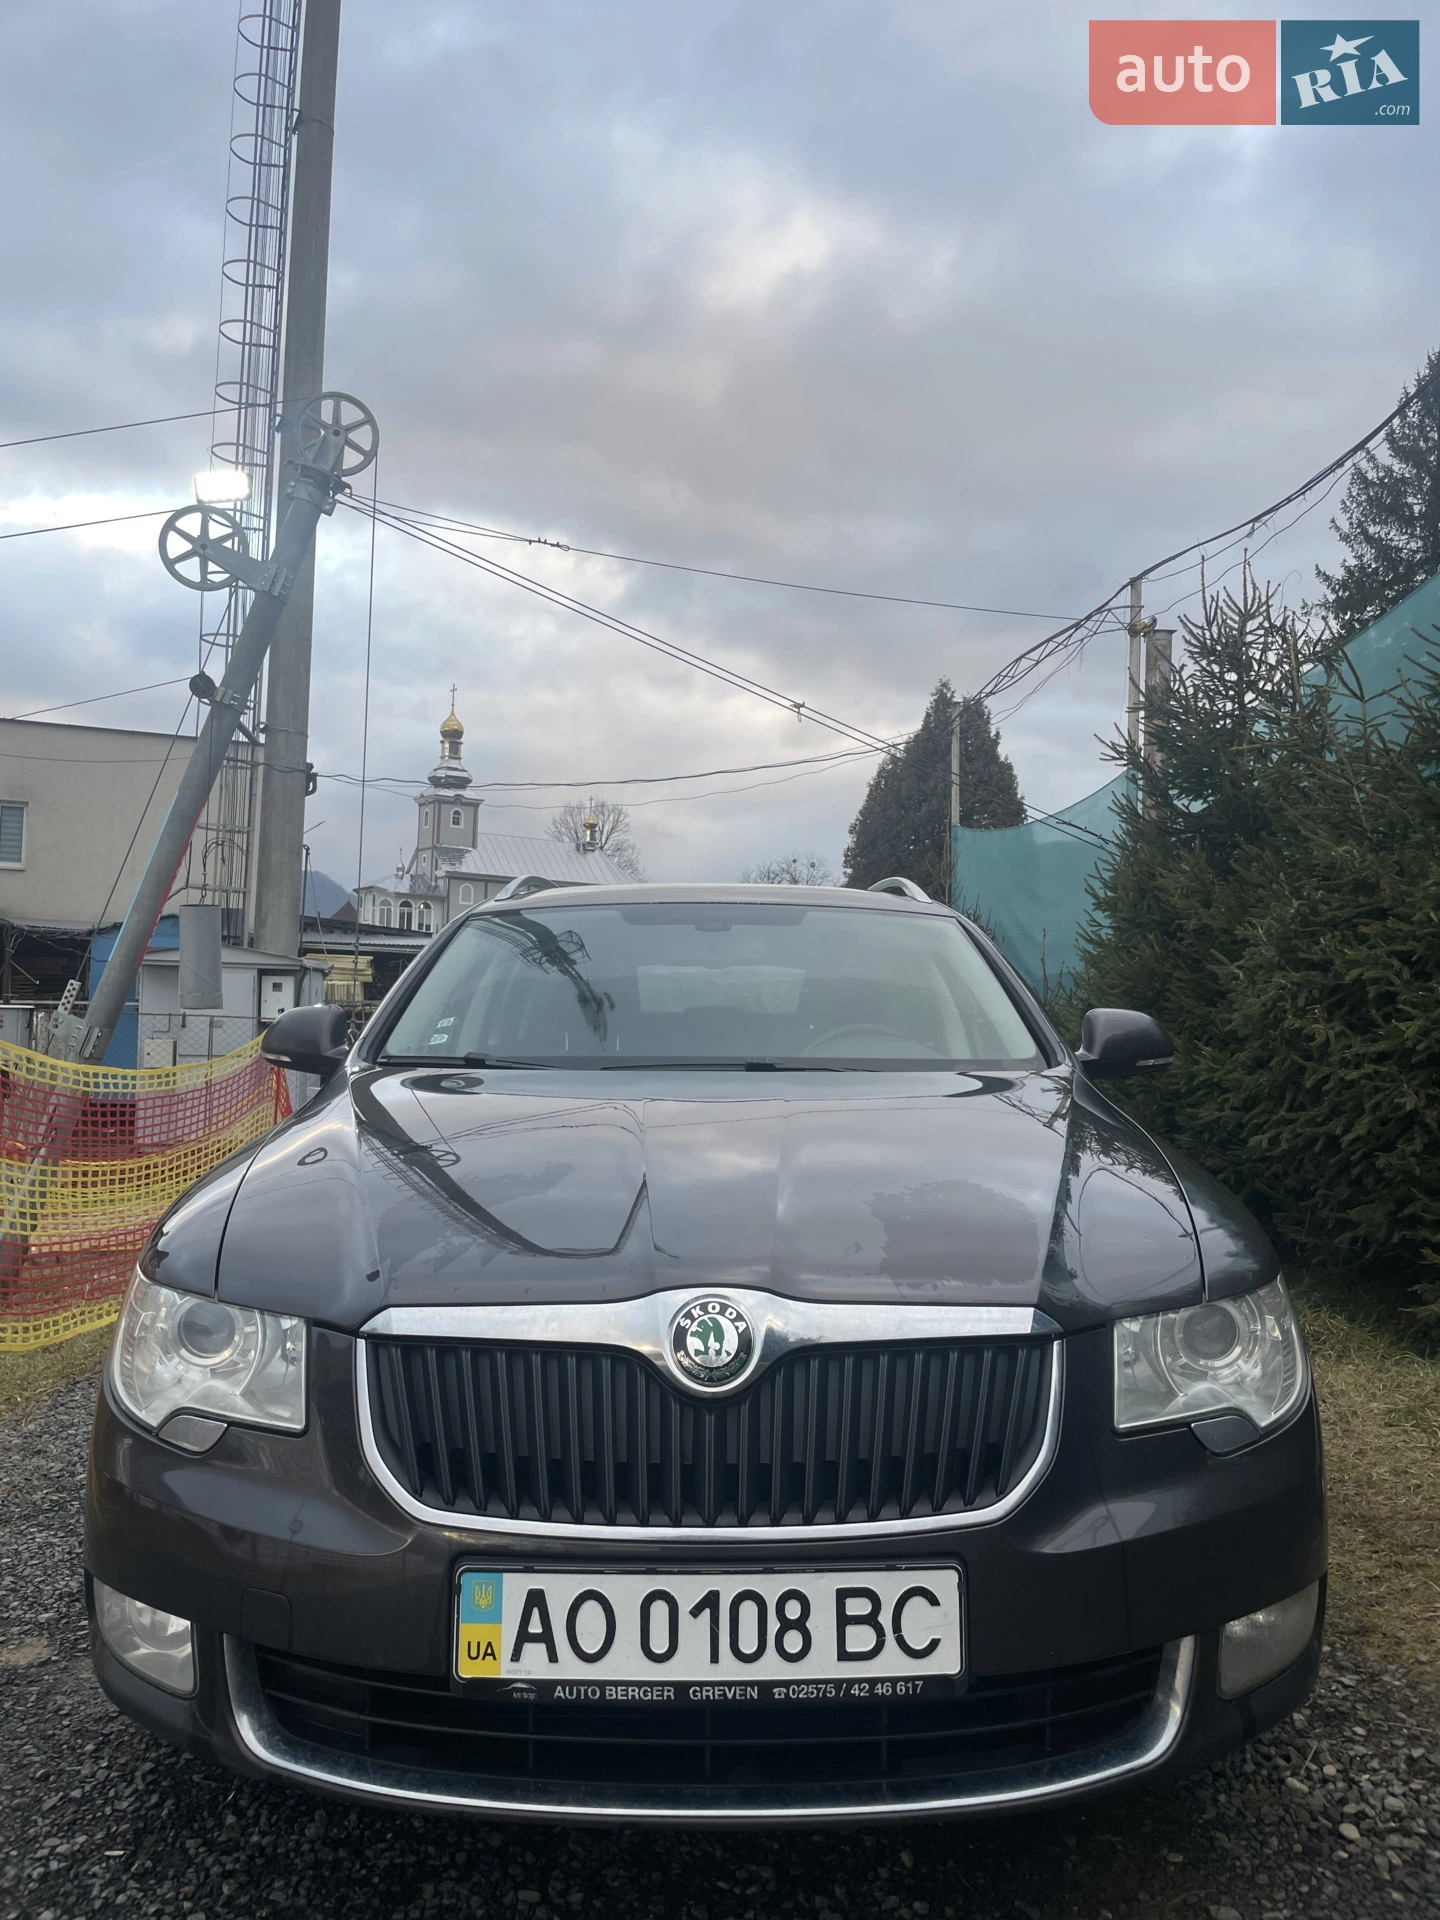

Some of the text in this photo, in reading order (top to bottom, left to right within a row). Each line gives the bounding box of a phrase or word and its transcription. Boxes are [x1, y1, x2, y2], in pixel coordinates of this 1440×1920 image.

[510, 1585, 942, 1664] AO 0108 BC
[467, 1640, 498, 1661] UA
[553, 1685, 600, 1700] AUTO
[605, 1686, 675, 1701] BERGER
[689, 1686, 759, 1700] GREVEN
[789, 1684, 835, 1699] 02575
[850, 1682, 870, 1697] 42
[874, 1682, 892, 1696] 46
[896, 1681, 924, 1695] 617
